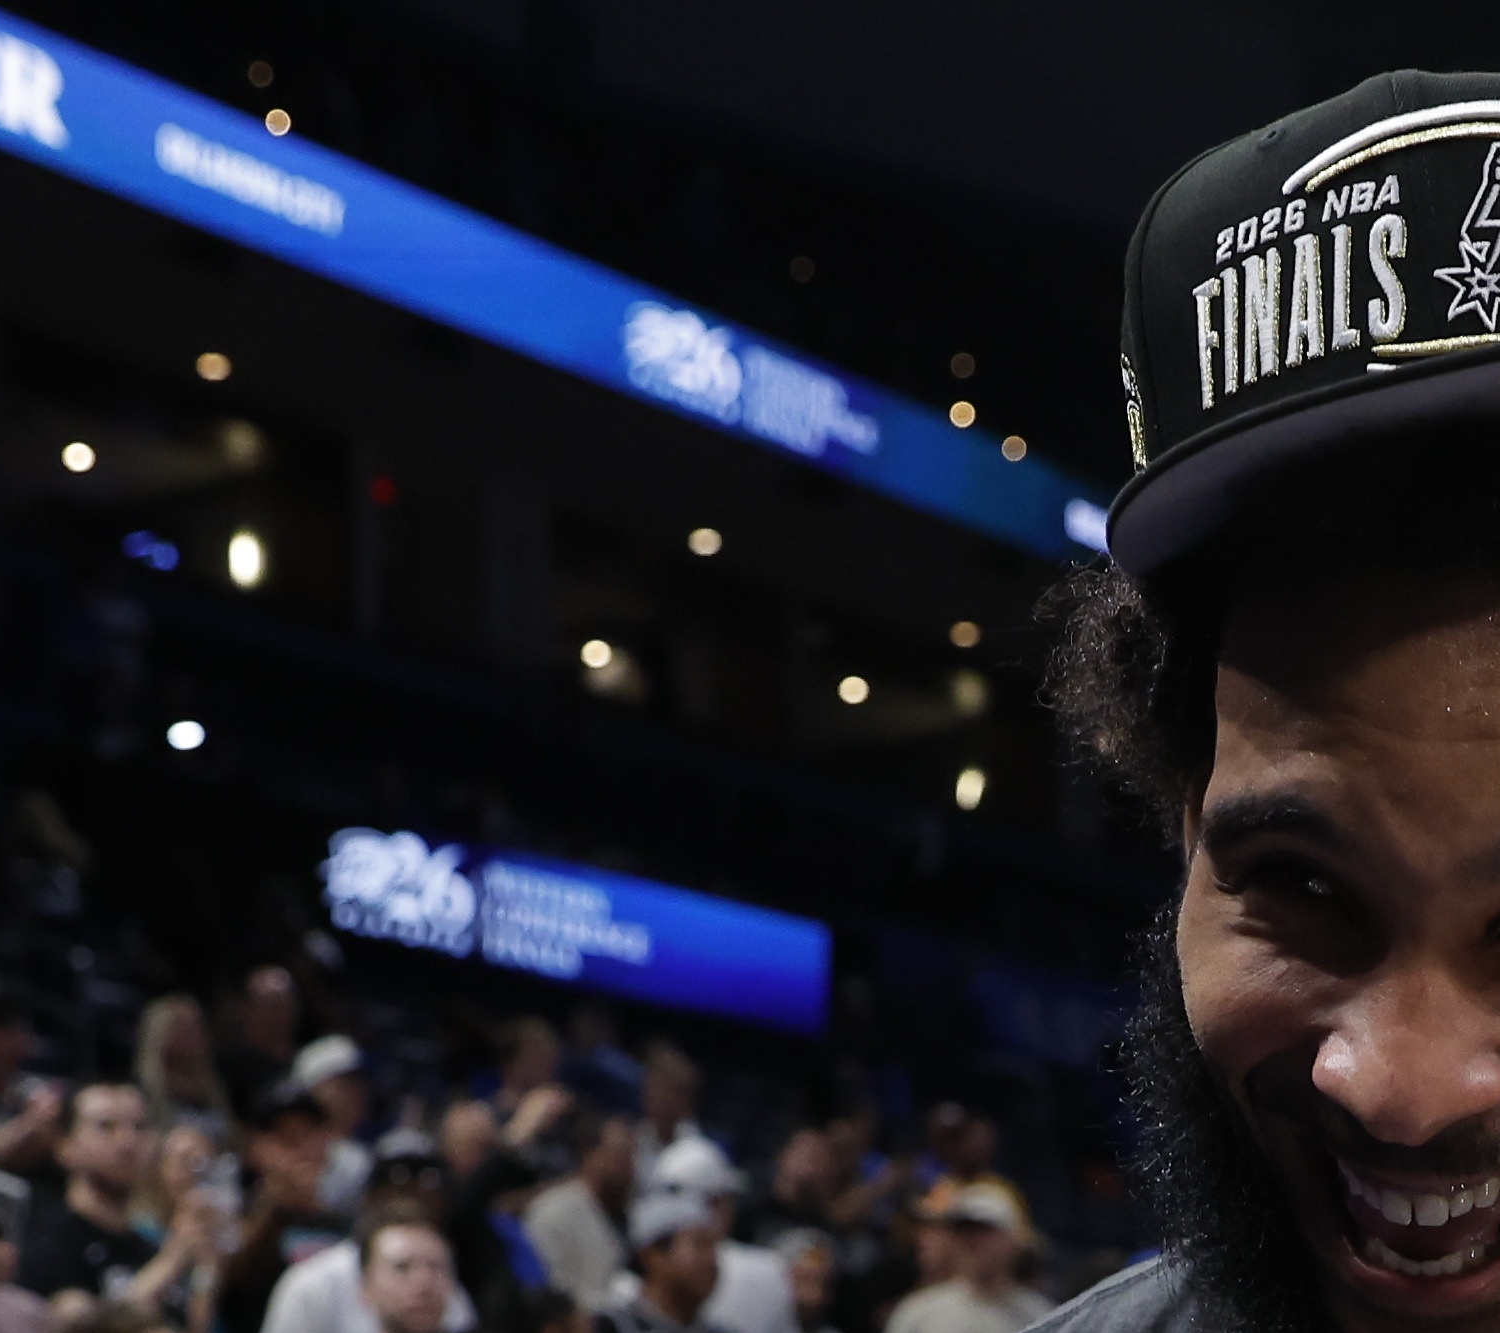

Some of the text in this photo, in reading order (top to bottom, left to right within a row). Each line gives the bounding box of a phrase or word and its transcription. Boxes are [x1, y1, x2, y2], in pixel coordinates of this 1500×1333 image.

[1216, 174, 1401, 265] 2026 NBA
[1192, 212, 1408, 411] FINALS
